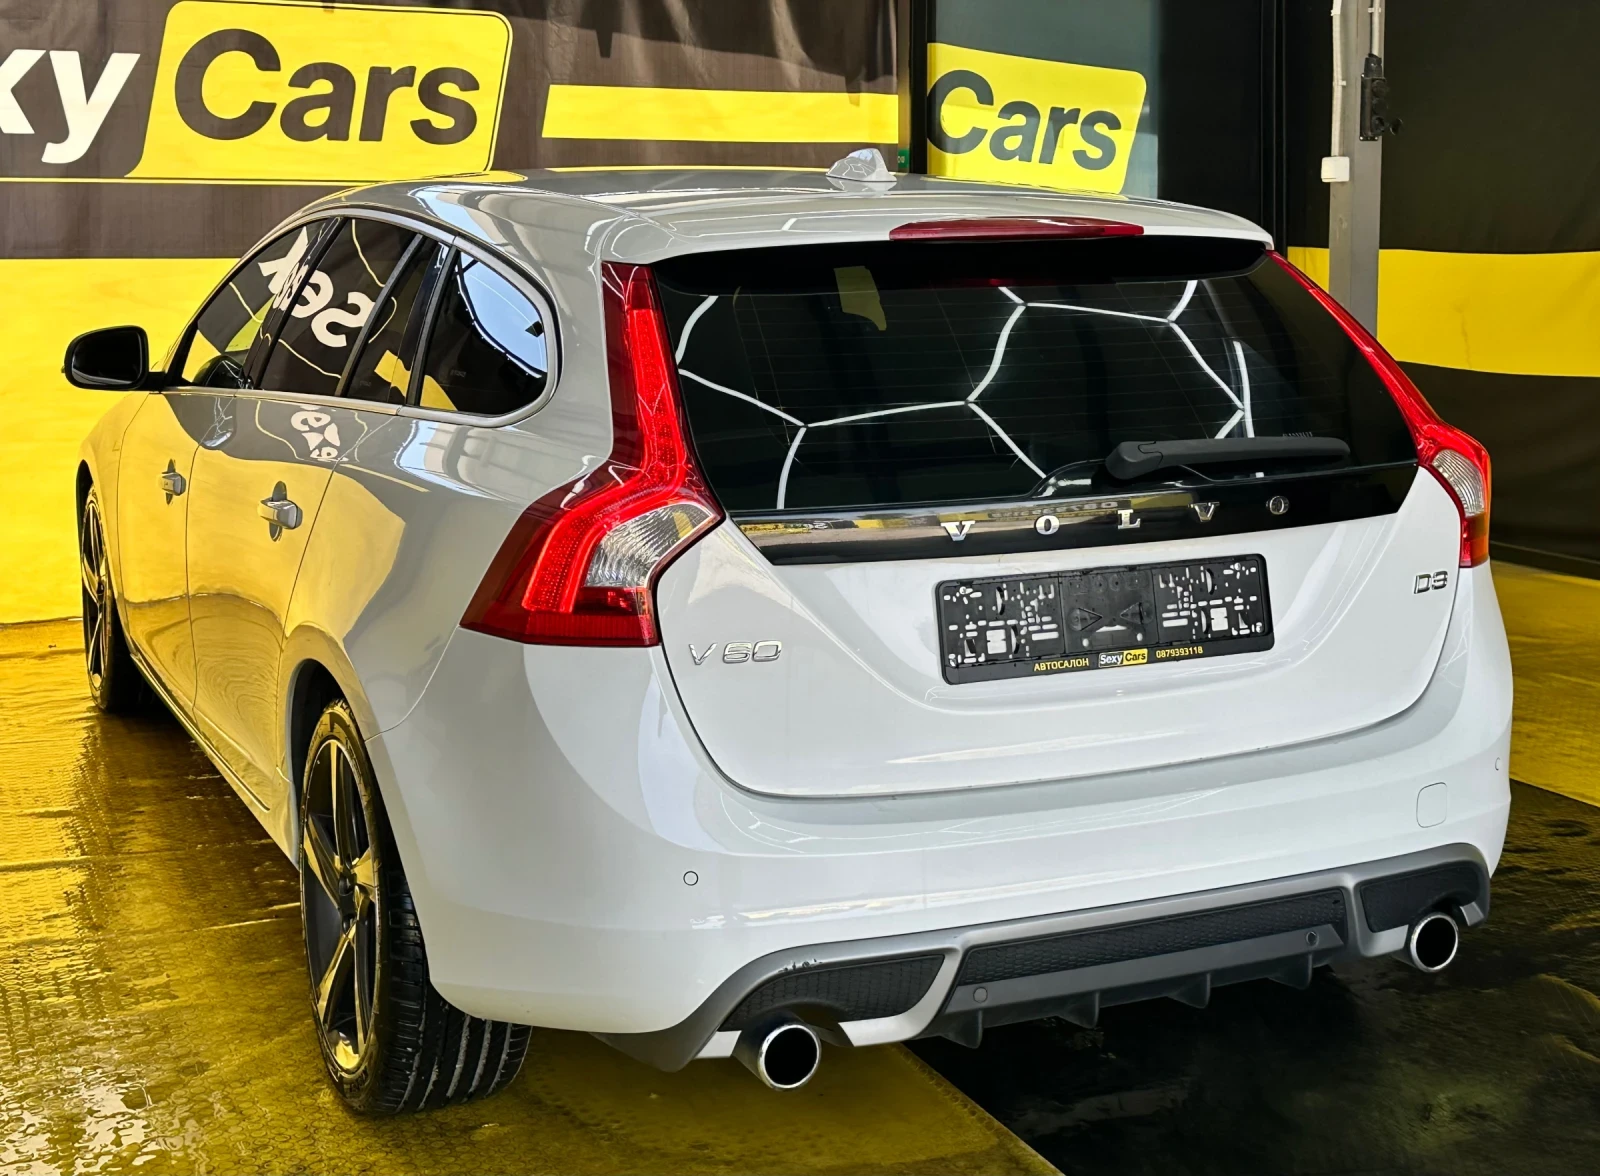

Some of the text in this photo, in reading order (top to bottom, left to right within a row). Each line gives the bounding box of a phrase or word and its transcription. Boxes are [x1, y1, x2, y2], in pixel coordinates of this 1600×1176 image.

[174, 28, 480, 146] Cars
[927, 69, 1122, 171] Cars
[940, 495, 1290, 542] VOLVO
[1413, 570, 1449, 595] D3
[1033, 657, 1090, 672] АВТОСАЛОН
[1099, 653, 1123, 666] Sexy
[1125, 652, 1146, 662] Cars
